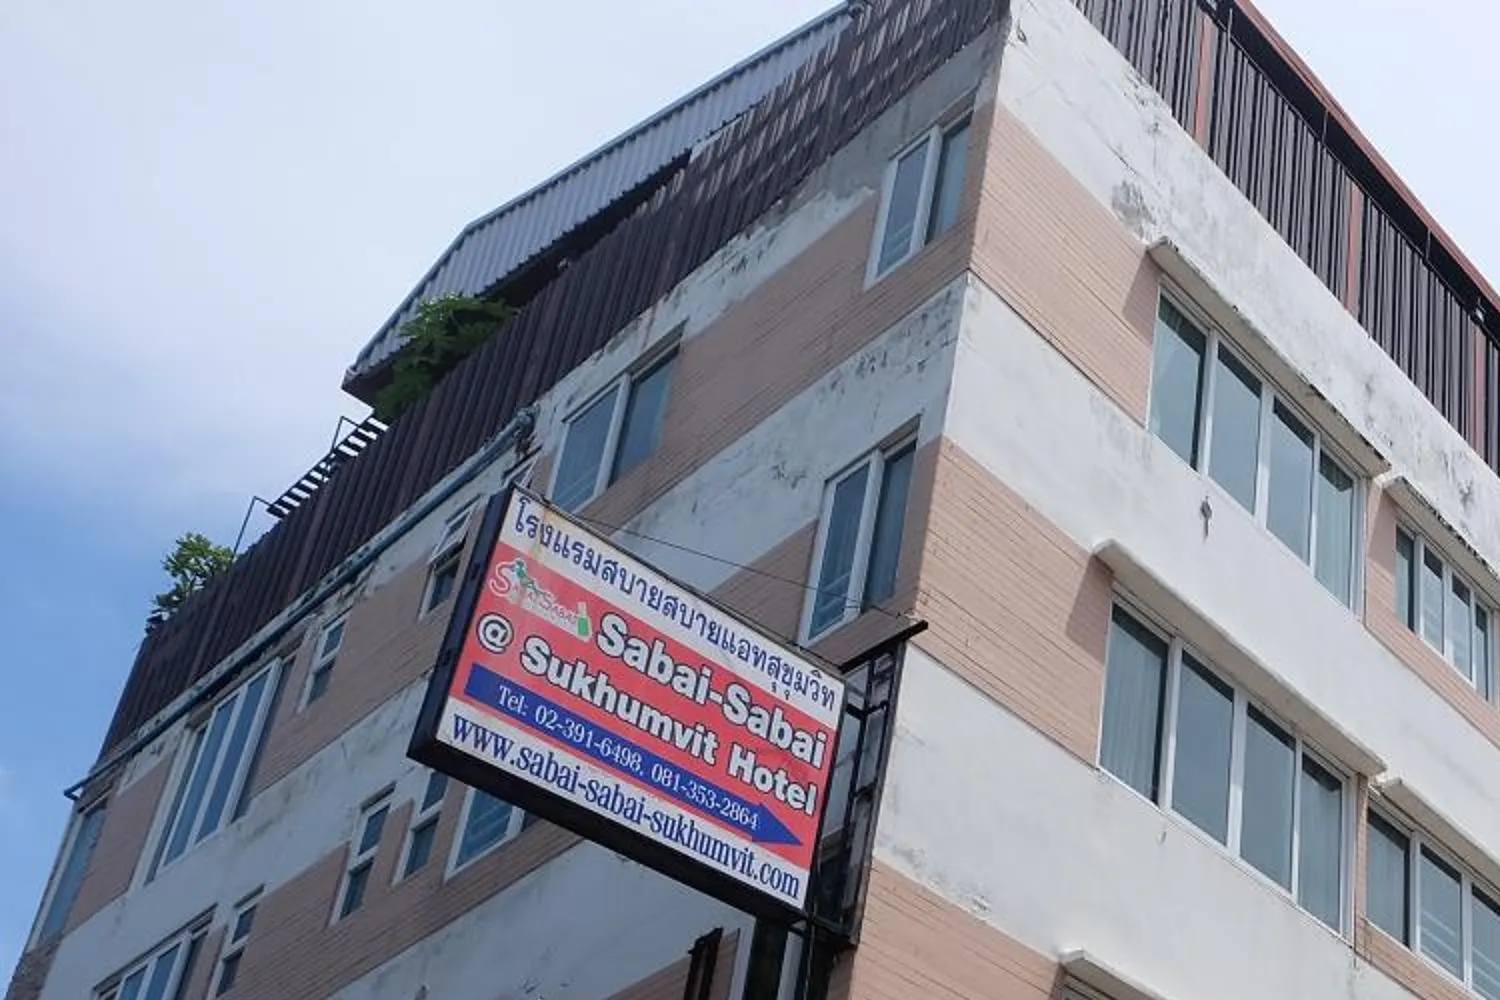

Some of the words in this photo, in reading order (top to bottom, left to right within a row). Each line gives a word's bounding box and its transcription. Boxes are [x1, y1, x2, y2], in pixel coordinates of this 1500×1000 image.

[476, 612, 515, 655] @
[519, 633, 720, 767] Sukhumvit
[727, 742, 818, 816] Hotel
[499, 685, 528, 717] Tel:
[651, 762, 760, 831] 081-353-2864
[595, 611, 828, 770] Sabai-Sabai
[452, 713, 801, 900] www.sabai-sabai-sukhumvit.com
